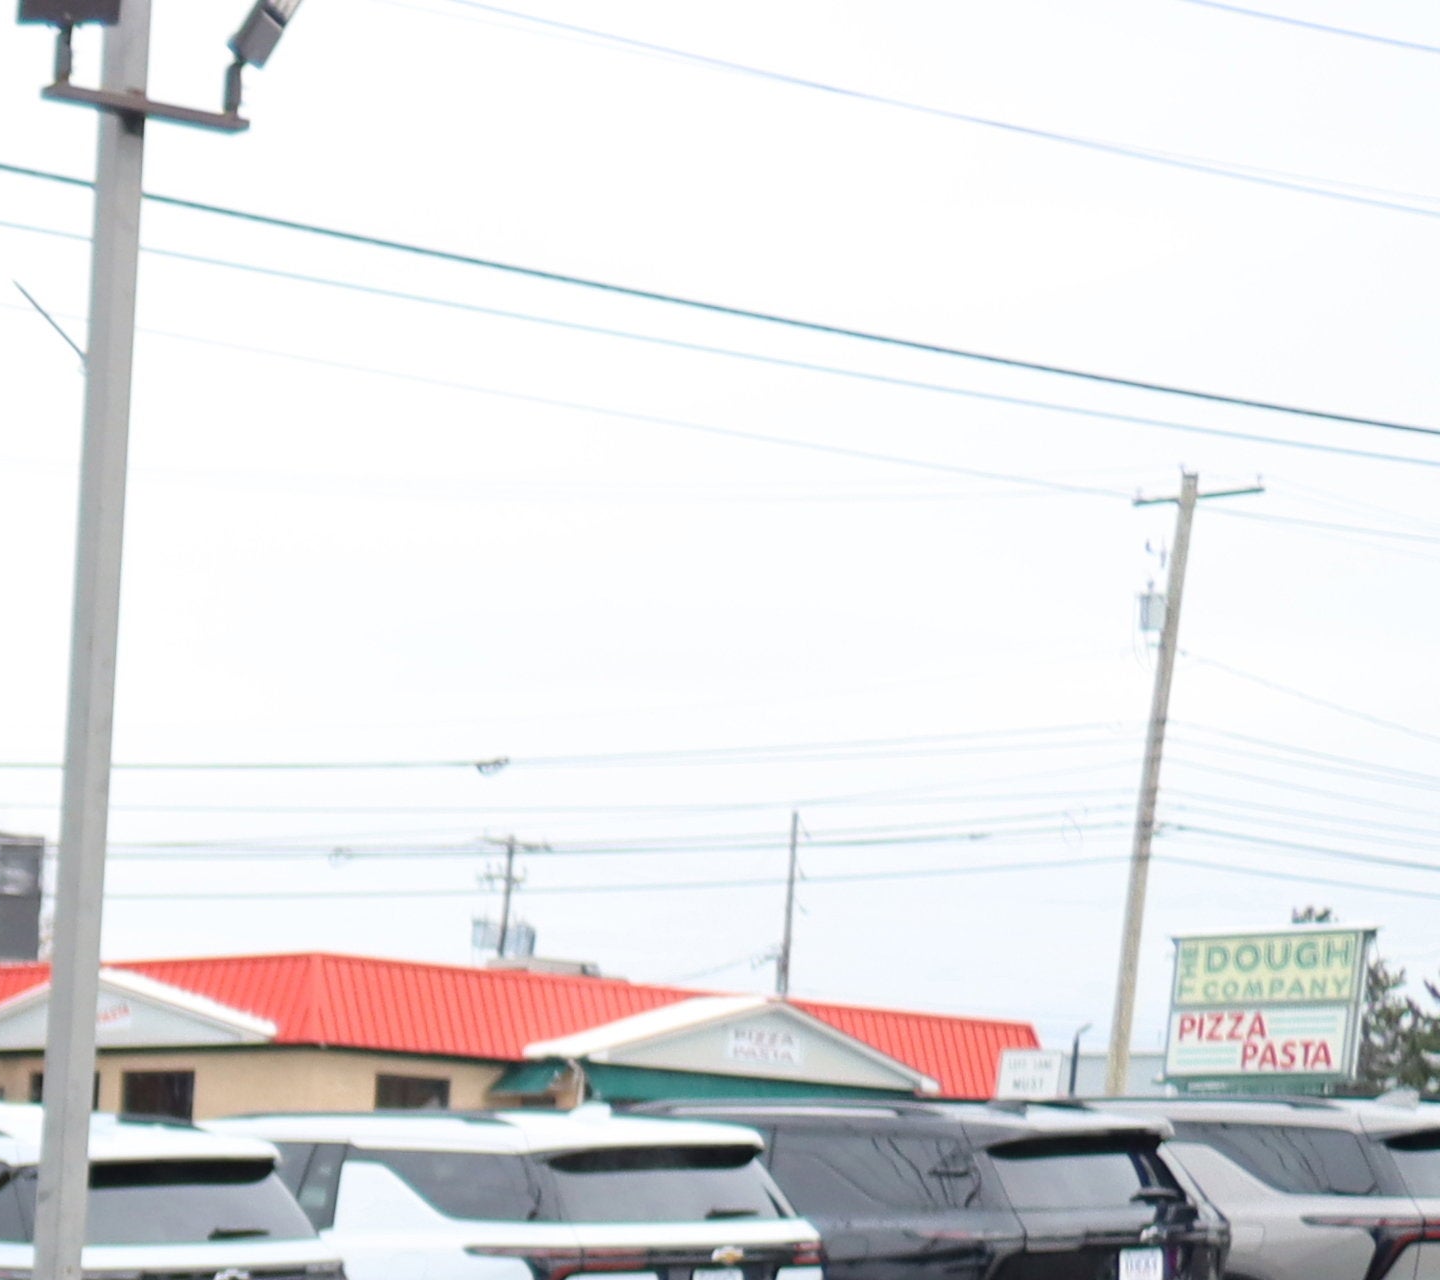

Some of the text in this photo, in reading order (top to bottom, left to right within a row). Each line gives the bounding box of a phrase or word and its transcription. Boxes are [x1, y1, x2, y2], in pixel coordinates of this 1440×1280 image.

[1181, 944, 1198, 996] THE
[1205, 937, 1353, 974] DOUGH
[1202, 976, 1349, 1001] COMPANY
[1179, 1011, 1267, 1042] PIZZA
[1241, 1041, 1333, 1071] PASTA
